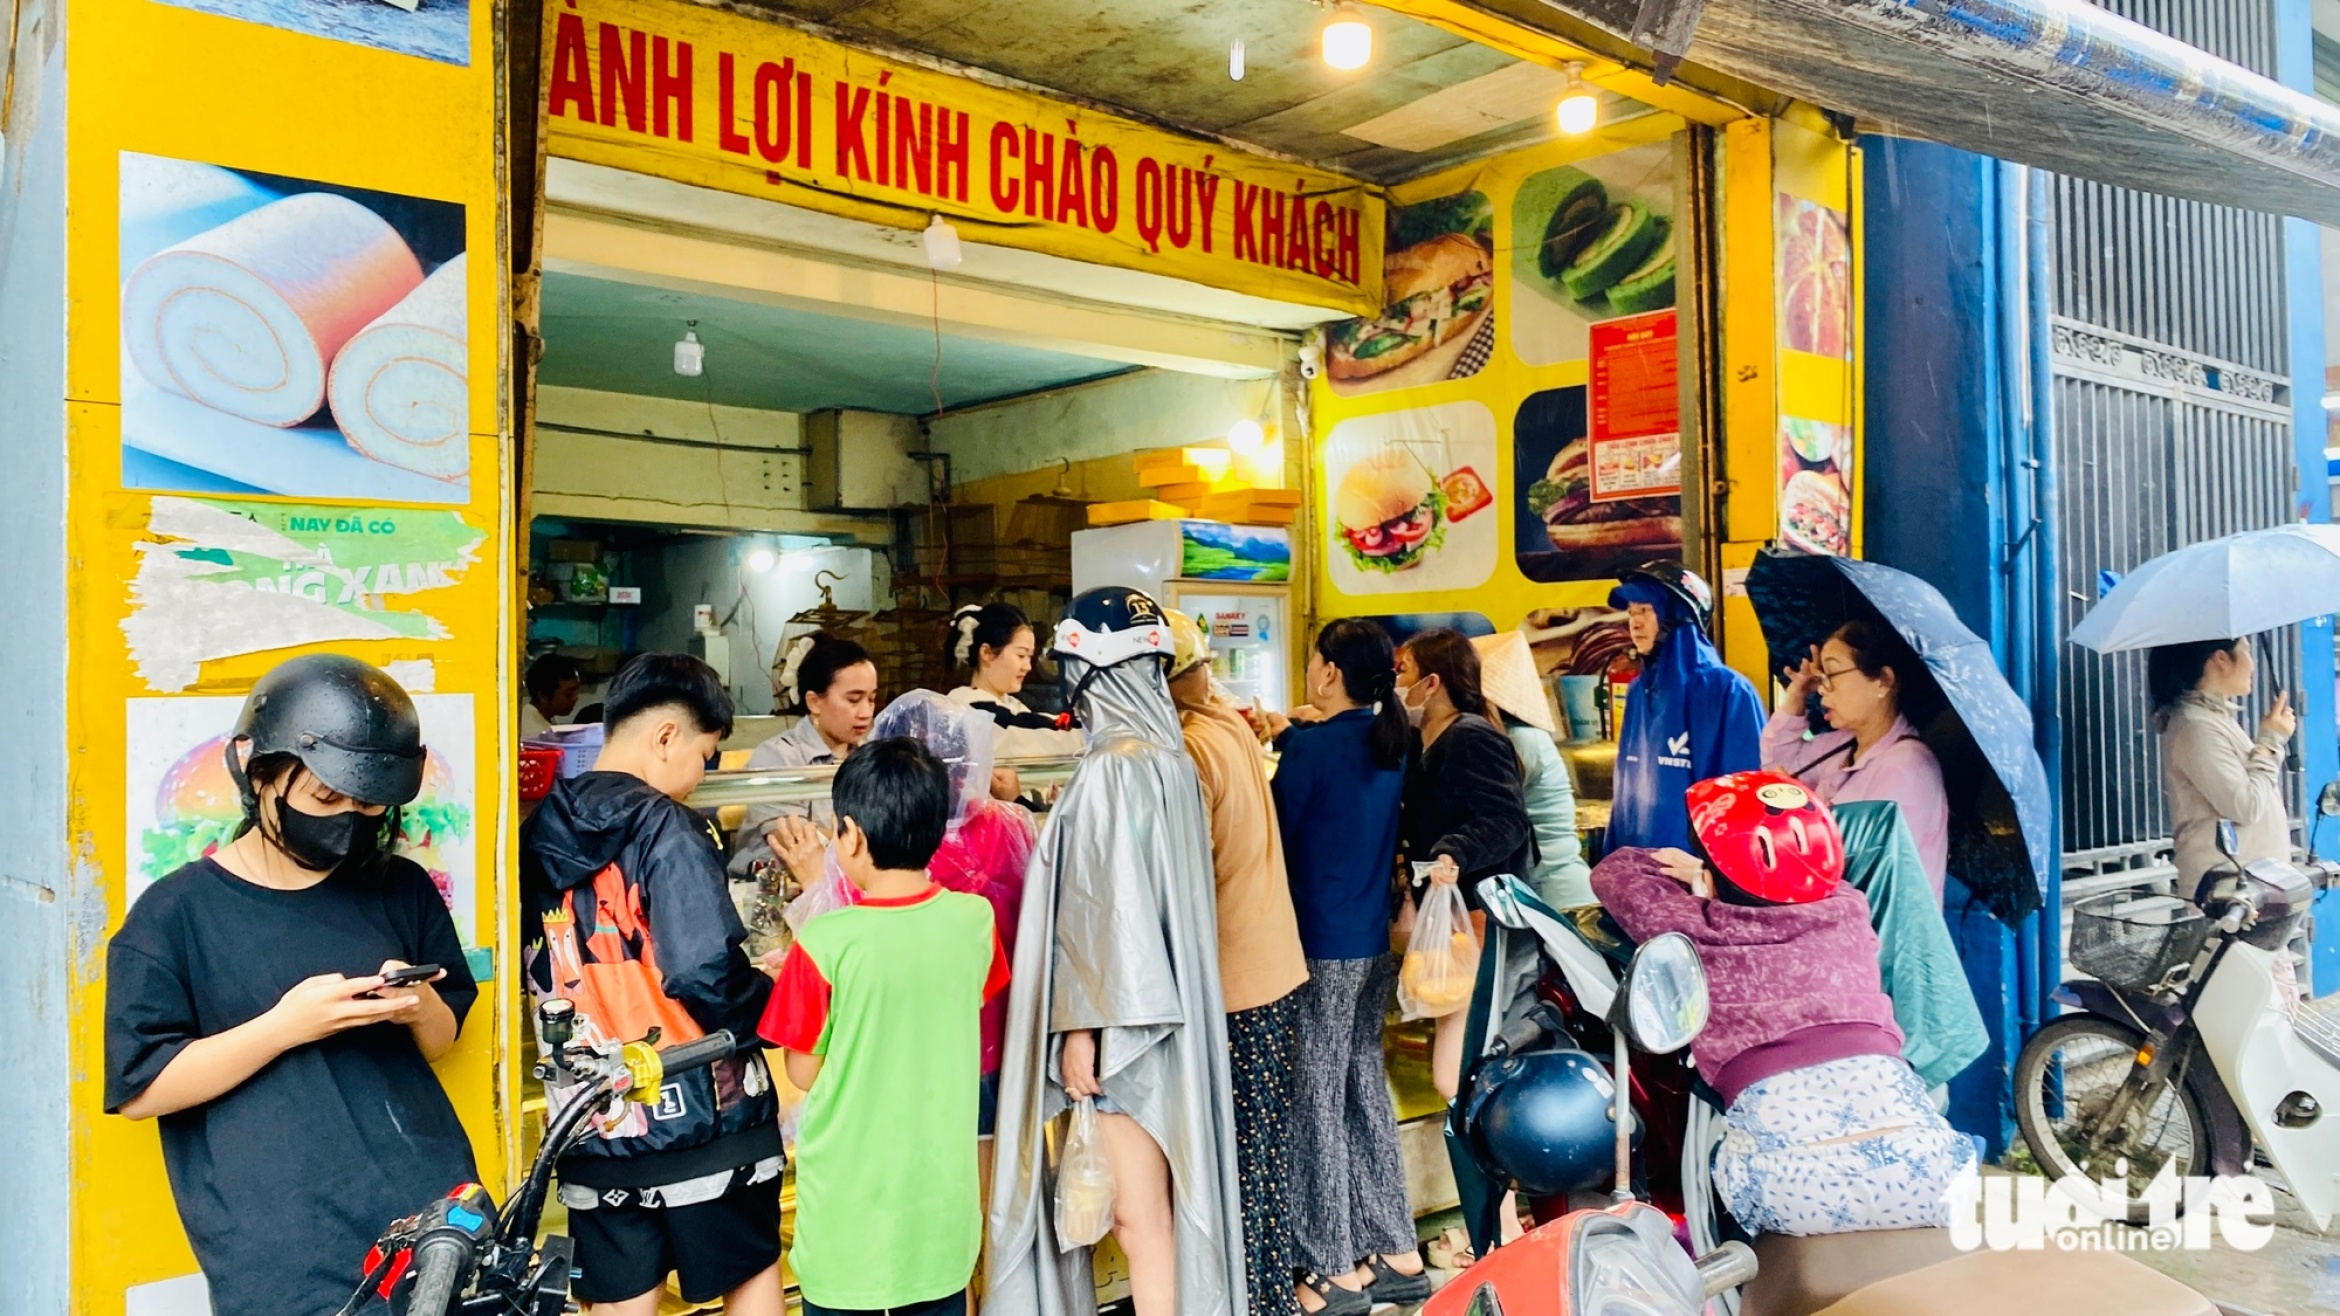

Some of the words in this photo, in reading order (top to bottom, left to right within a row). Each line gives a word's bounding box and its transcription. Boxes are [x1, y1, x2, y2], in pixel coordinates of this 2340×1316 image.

[719, 51, 812, 185] LỢI
[836, 71, 969, 204] KÍNH
[989, 118, 1119, 234] CHÀO
[1135, 154, 1220, 254] QUÝ
[1233, 179, 1361, 285] KHÁCH
[290, 517, 331, 532] NAY
[335, 516, 364, 533] ĐÃ
[368, 517, 396, 535] CÓ
